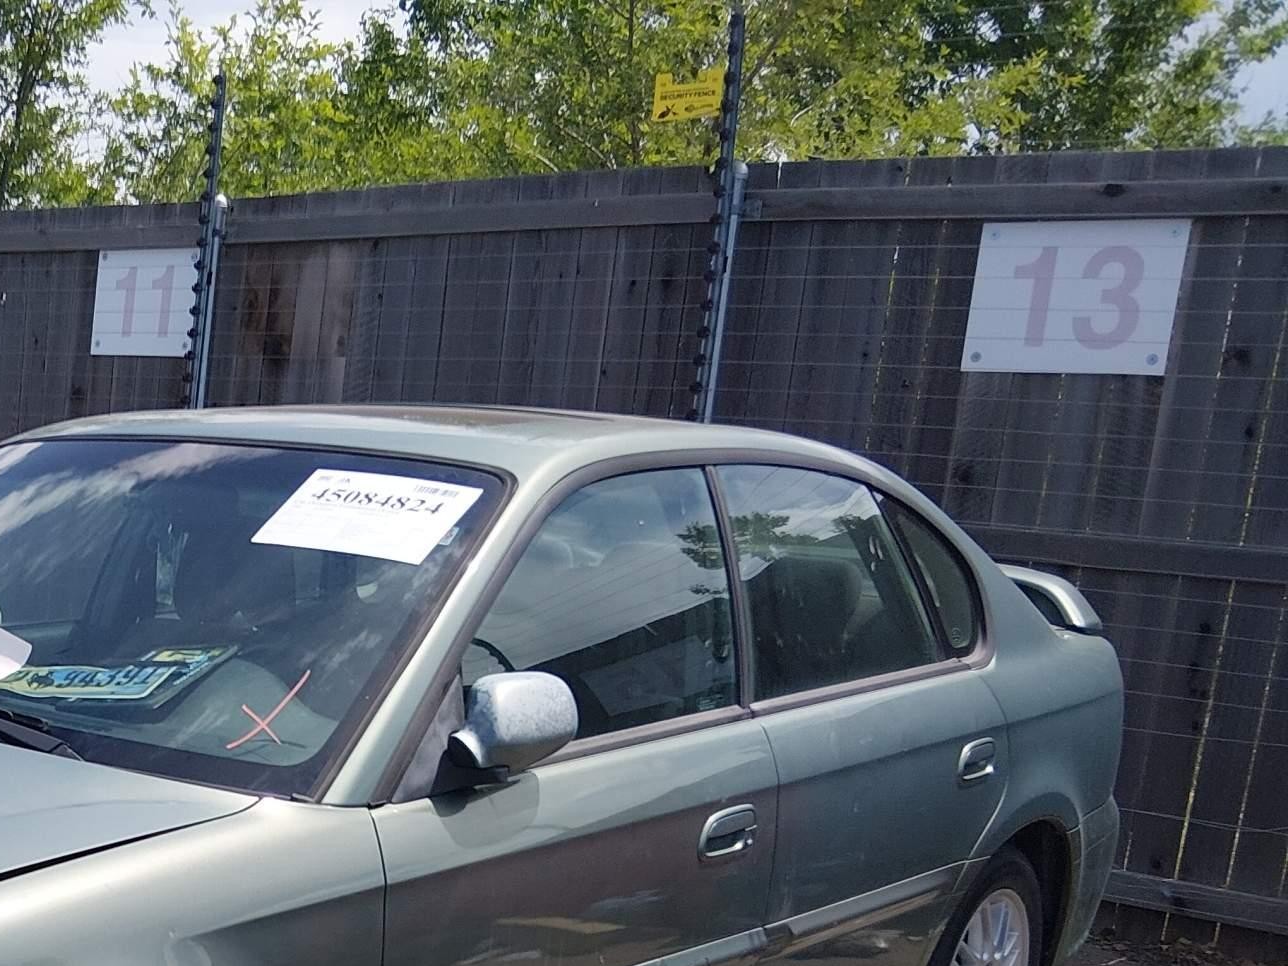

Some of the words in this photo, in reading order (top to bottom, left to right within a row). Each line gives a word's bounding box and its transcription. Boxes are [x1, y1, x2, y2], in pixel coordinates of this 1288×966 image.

[115, 265, 175, 338] 11
[1014, 245, 1145, 350] 13
[312, 487, 444, 514] 45084824
